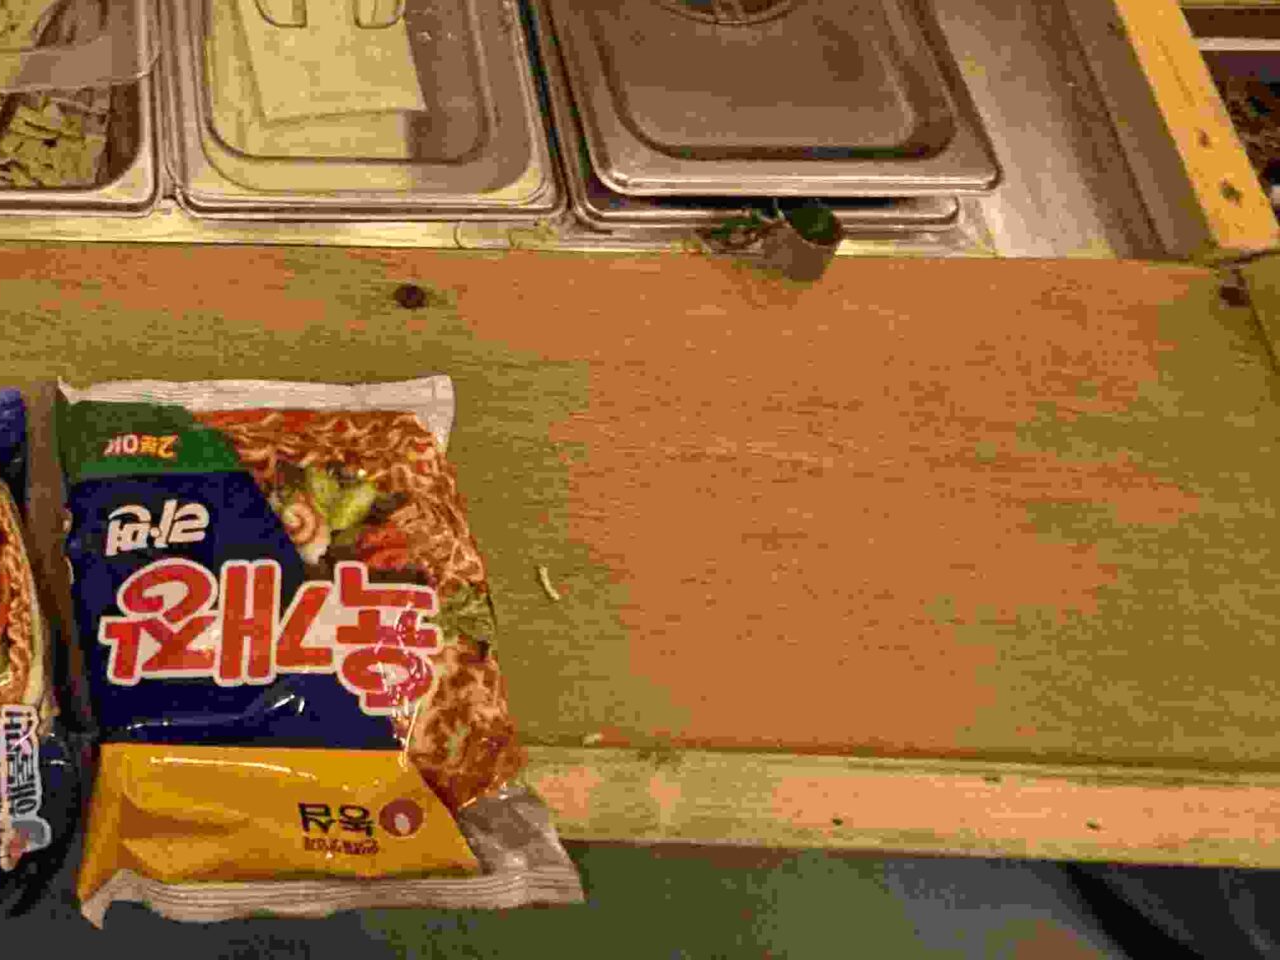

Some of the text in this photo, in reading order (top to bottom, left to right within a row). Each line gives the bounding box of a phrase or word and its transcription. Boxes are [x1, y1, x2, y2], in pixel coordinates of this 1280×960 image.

[106, 499, 210, 556] 라면
[99, 557, 443, 716] 육개장
[298, 803, 378, 839] 농심
